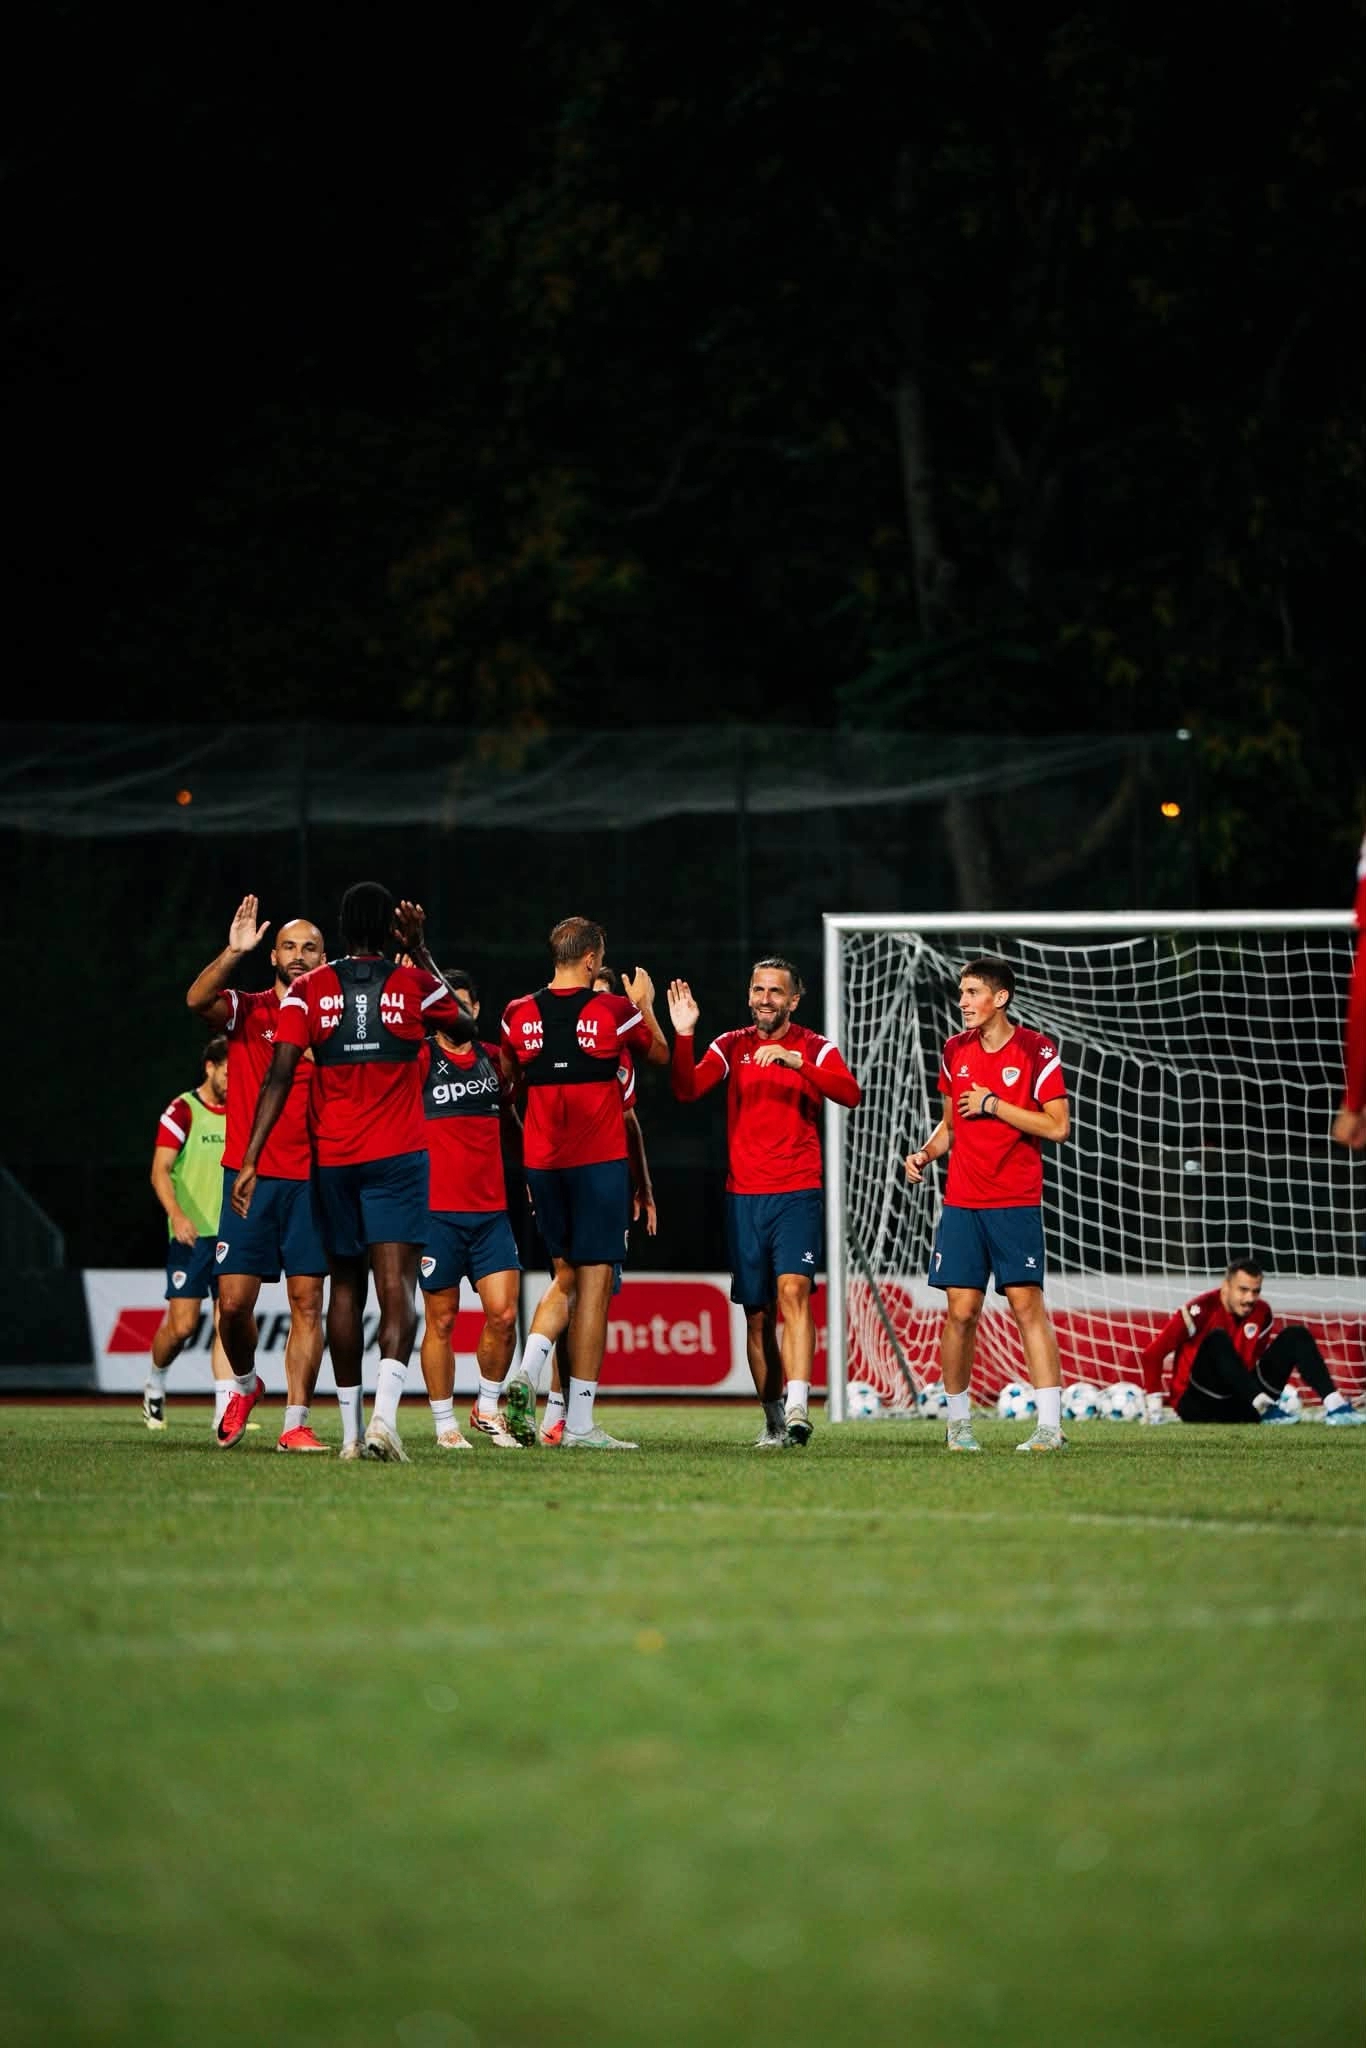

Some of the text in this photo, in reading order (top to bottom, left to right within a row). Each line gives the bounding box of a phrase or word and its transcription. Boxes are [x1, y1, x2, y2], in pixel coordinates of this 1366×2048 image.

[320, 994, 344, 1010] ФК
[356, 994, 367, 1040] gpexe
[522, 1020, 543, 1035] ФК
[432, 1076, 499, 1104] gpexe
[201, 1134, 225, 1144] KEL
